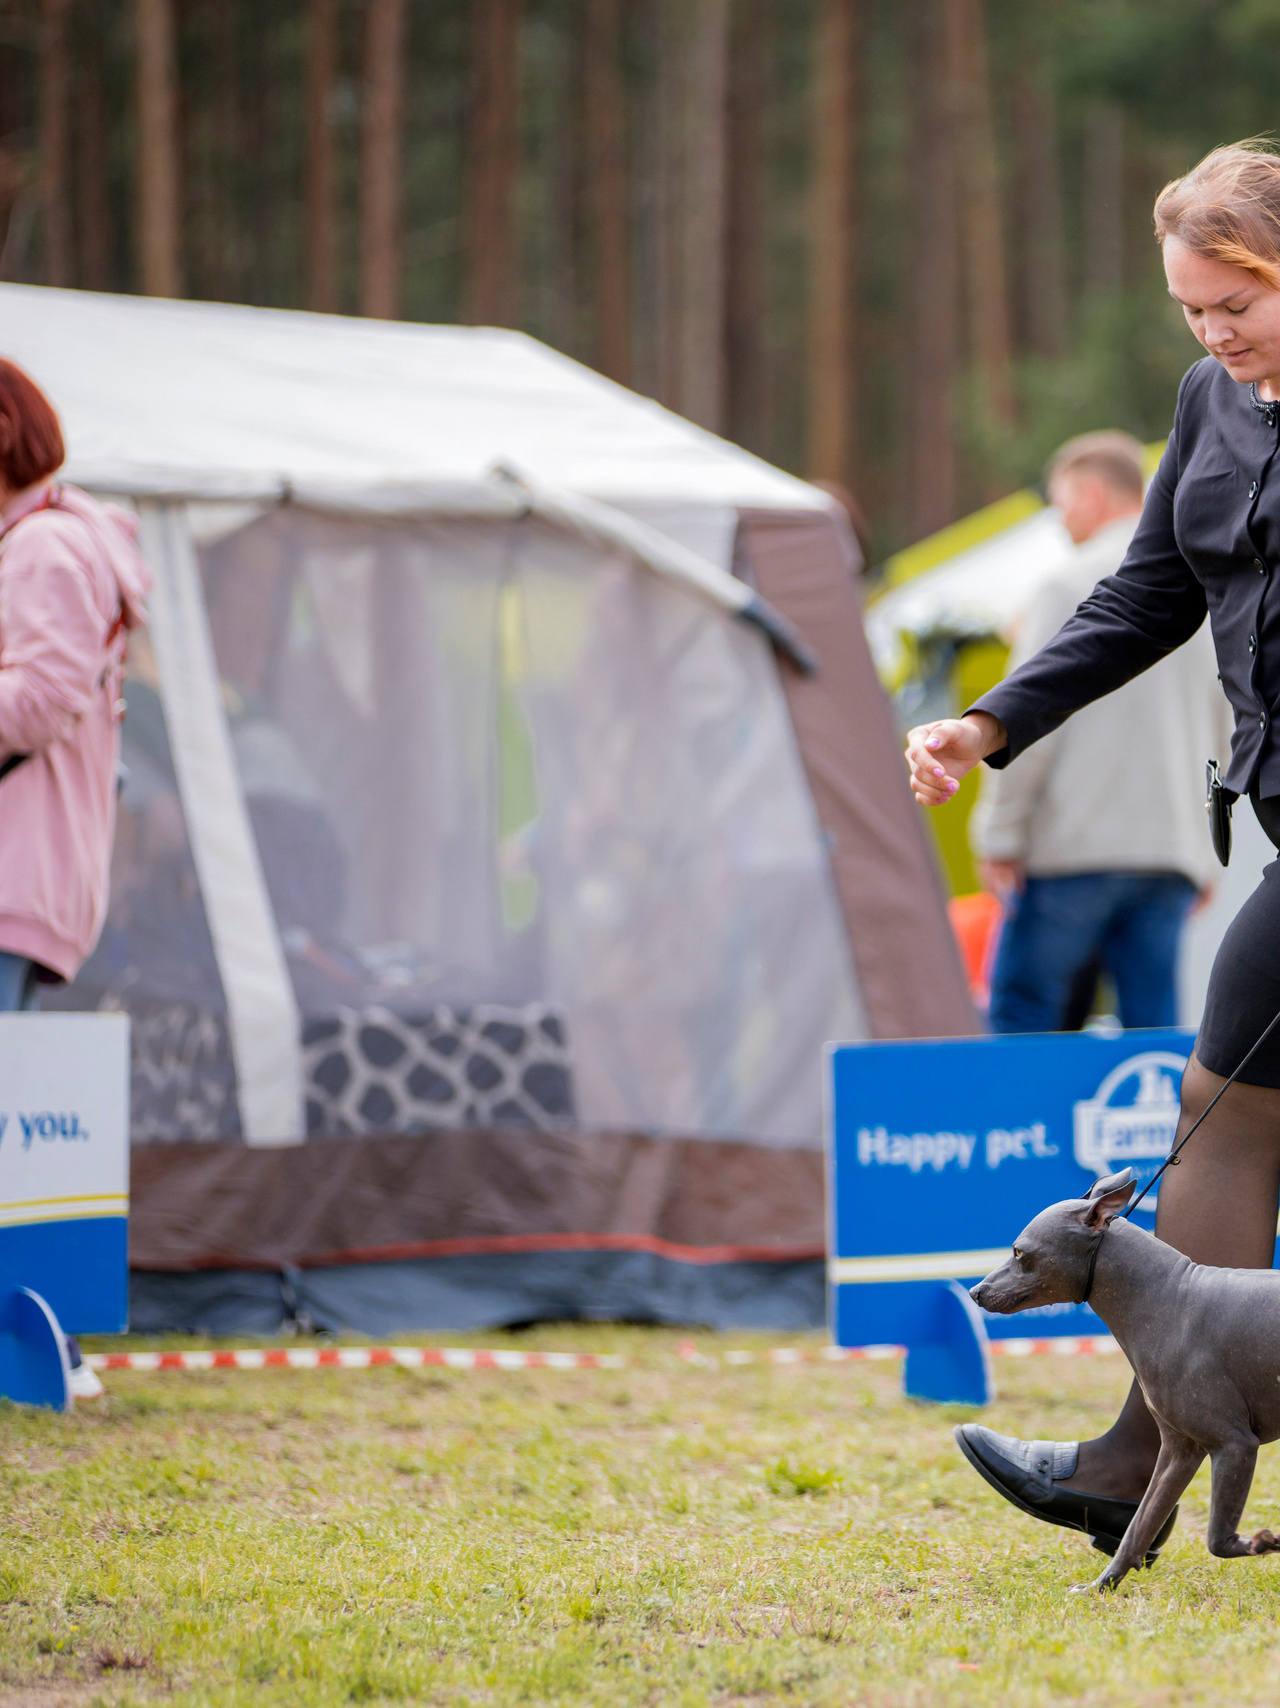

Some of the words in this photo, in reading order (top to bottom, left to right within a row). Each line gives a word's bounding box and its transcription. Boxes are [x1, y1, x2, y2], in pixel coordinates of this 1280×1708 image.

[18, 1111, 90, 1151] you.
[857, 1123, 976, 1171] Happy
[985, 1122, 1060, 1168] pet.
